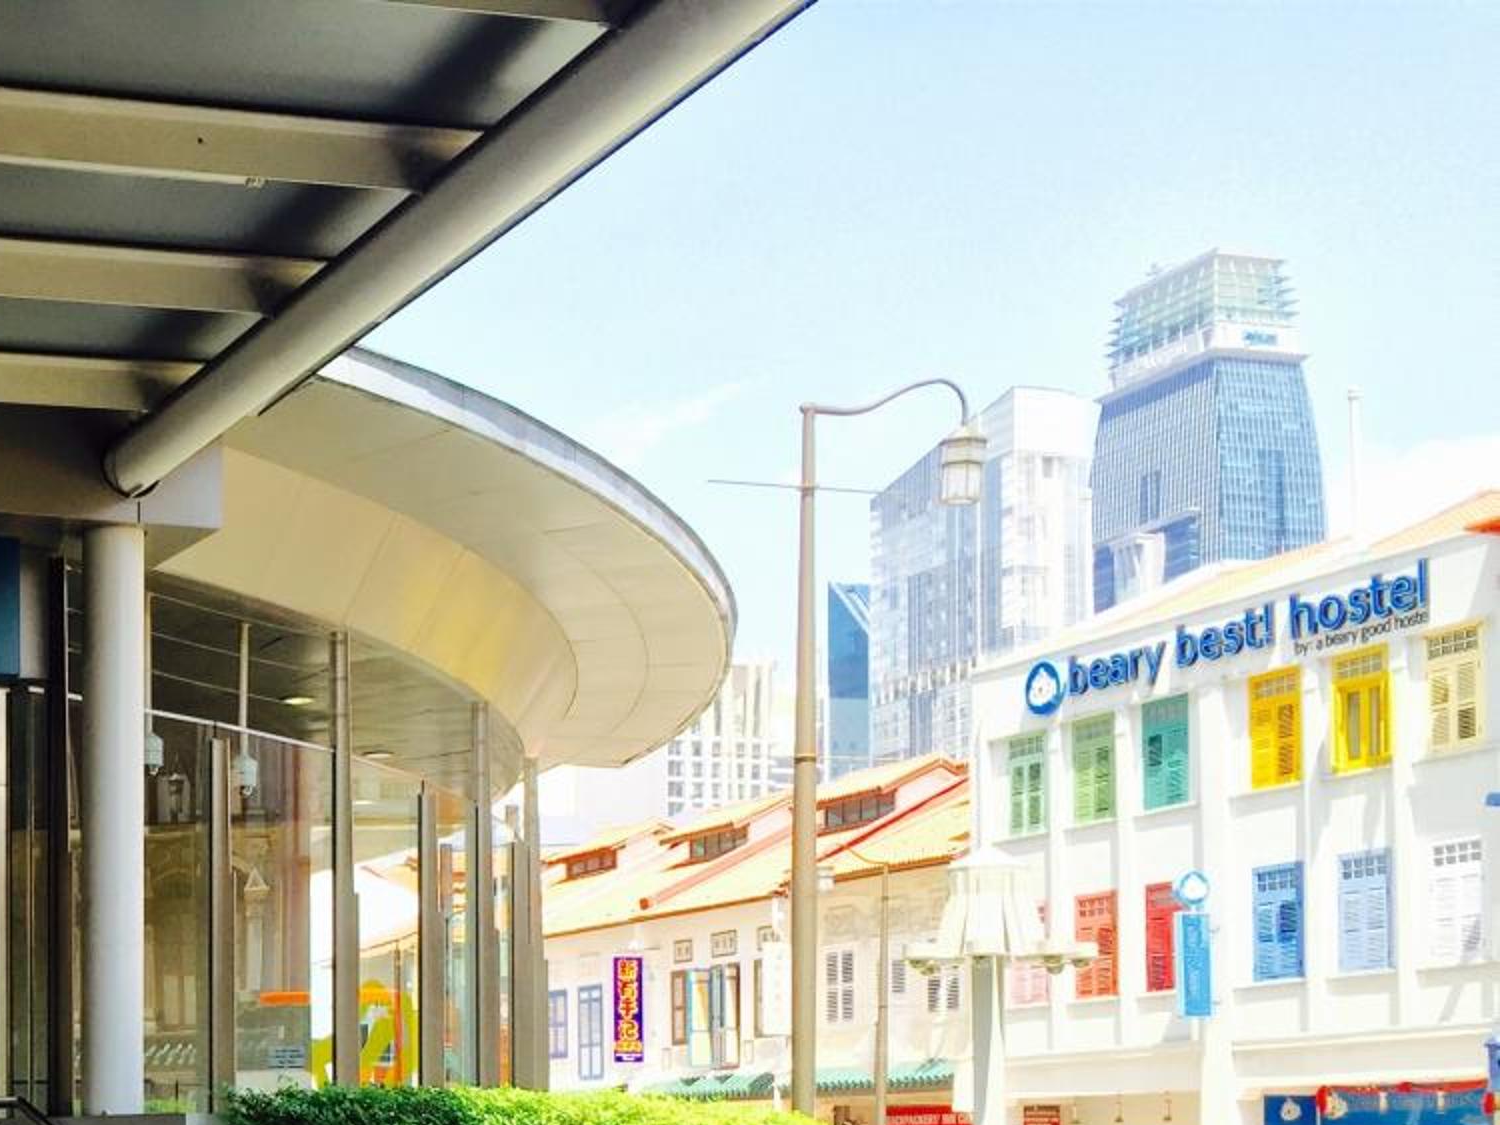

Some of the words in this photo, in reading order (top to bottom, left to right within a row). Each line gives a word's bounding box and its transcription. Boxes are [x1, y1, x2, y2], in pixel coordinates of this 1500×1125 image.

[1068, 641, 1167, 696] beary
[1175, 602, 1276, 668] best!
[1289, 558, 1429, 640] hostel
